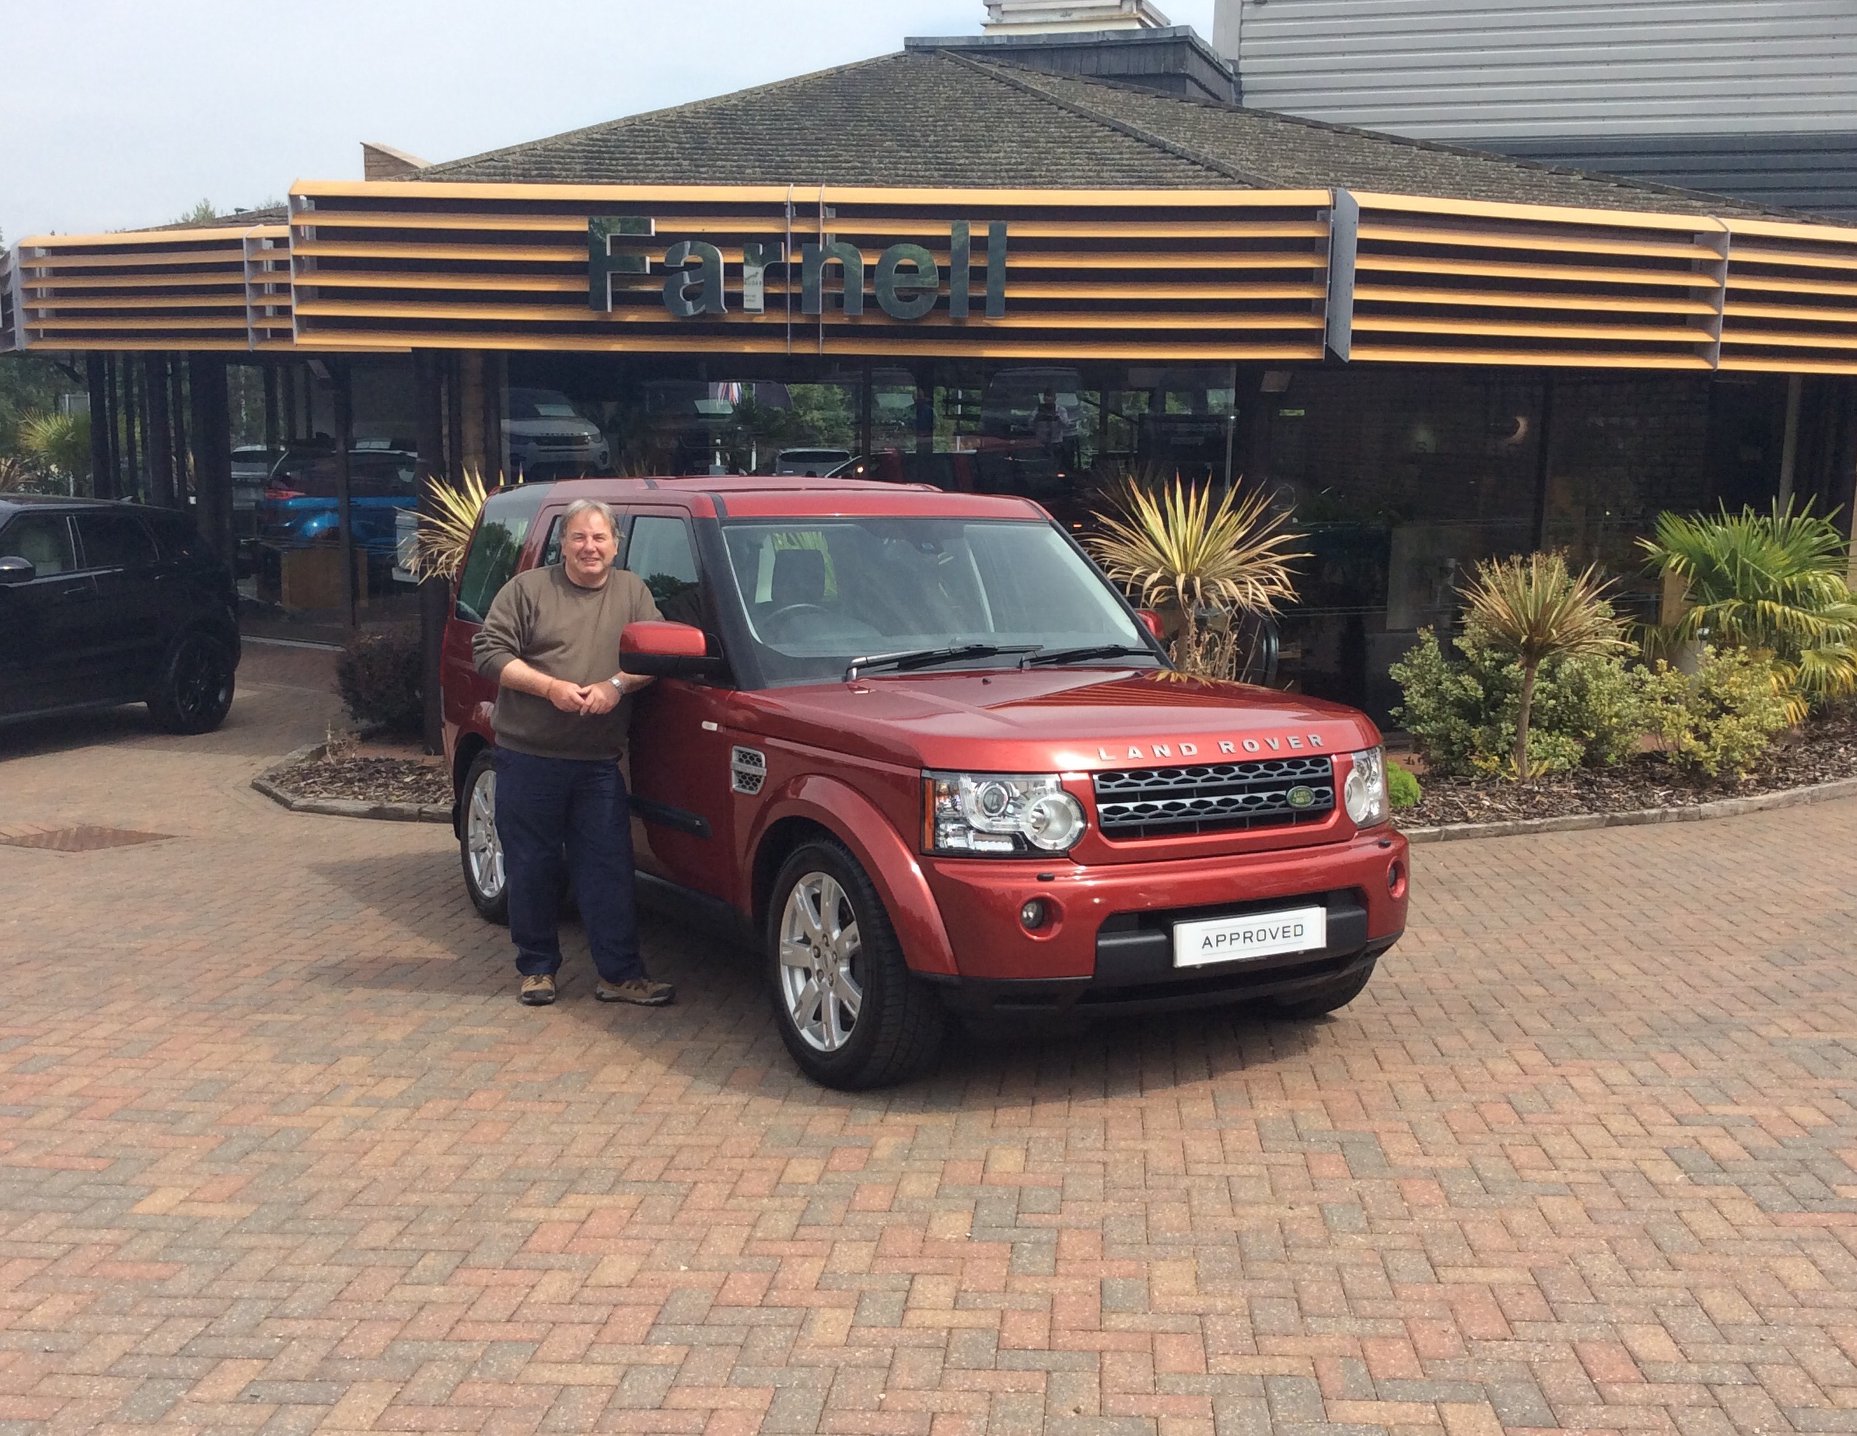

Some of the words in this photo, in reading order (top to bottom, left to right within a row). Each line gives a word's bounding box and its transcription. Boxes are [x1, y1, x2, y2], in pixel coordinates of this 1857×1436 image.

[588, 215, 1007, 319] Farnell
[1097, 742, 1198, 761] LAND
[1217, 733, 1324, 754] ROVER
[1201, 923, 1304, 949] APPROVED
